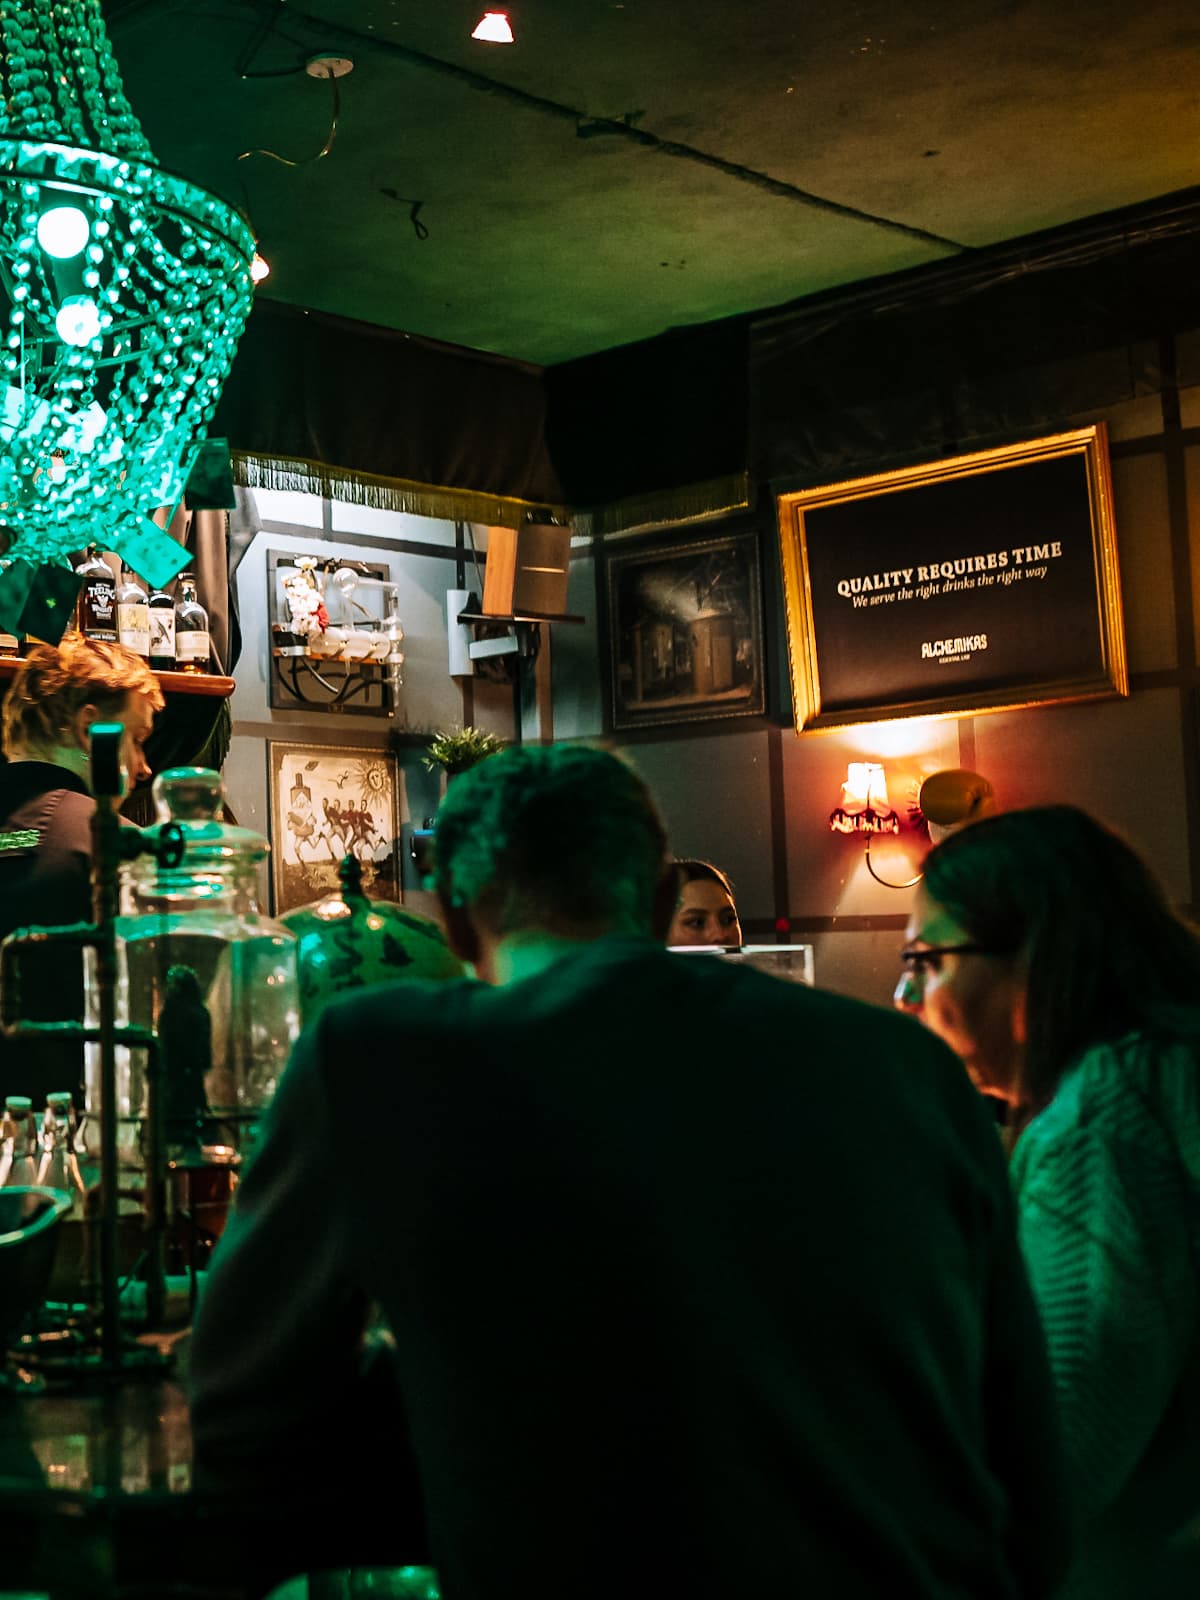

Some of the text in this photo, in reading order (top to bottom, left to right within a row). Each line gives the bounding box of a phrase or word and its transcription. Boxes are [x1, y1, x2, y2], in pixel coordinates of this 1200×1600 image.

[837, 541, 1062, 598] QUALITY REQUIRES TIME
[853, 566, 1048, 608] We serve the right drinks the right way
[921, 633, 988, 659] ALCHEMIKAS
